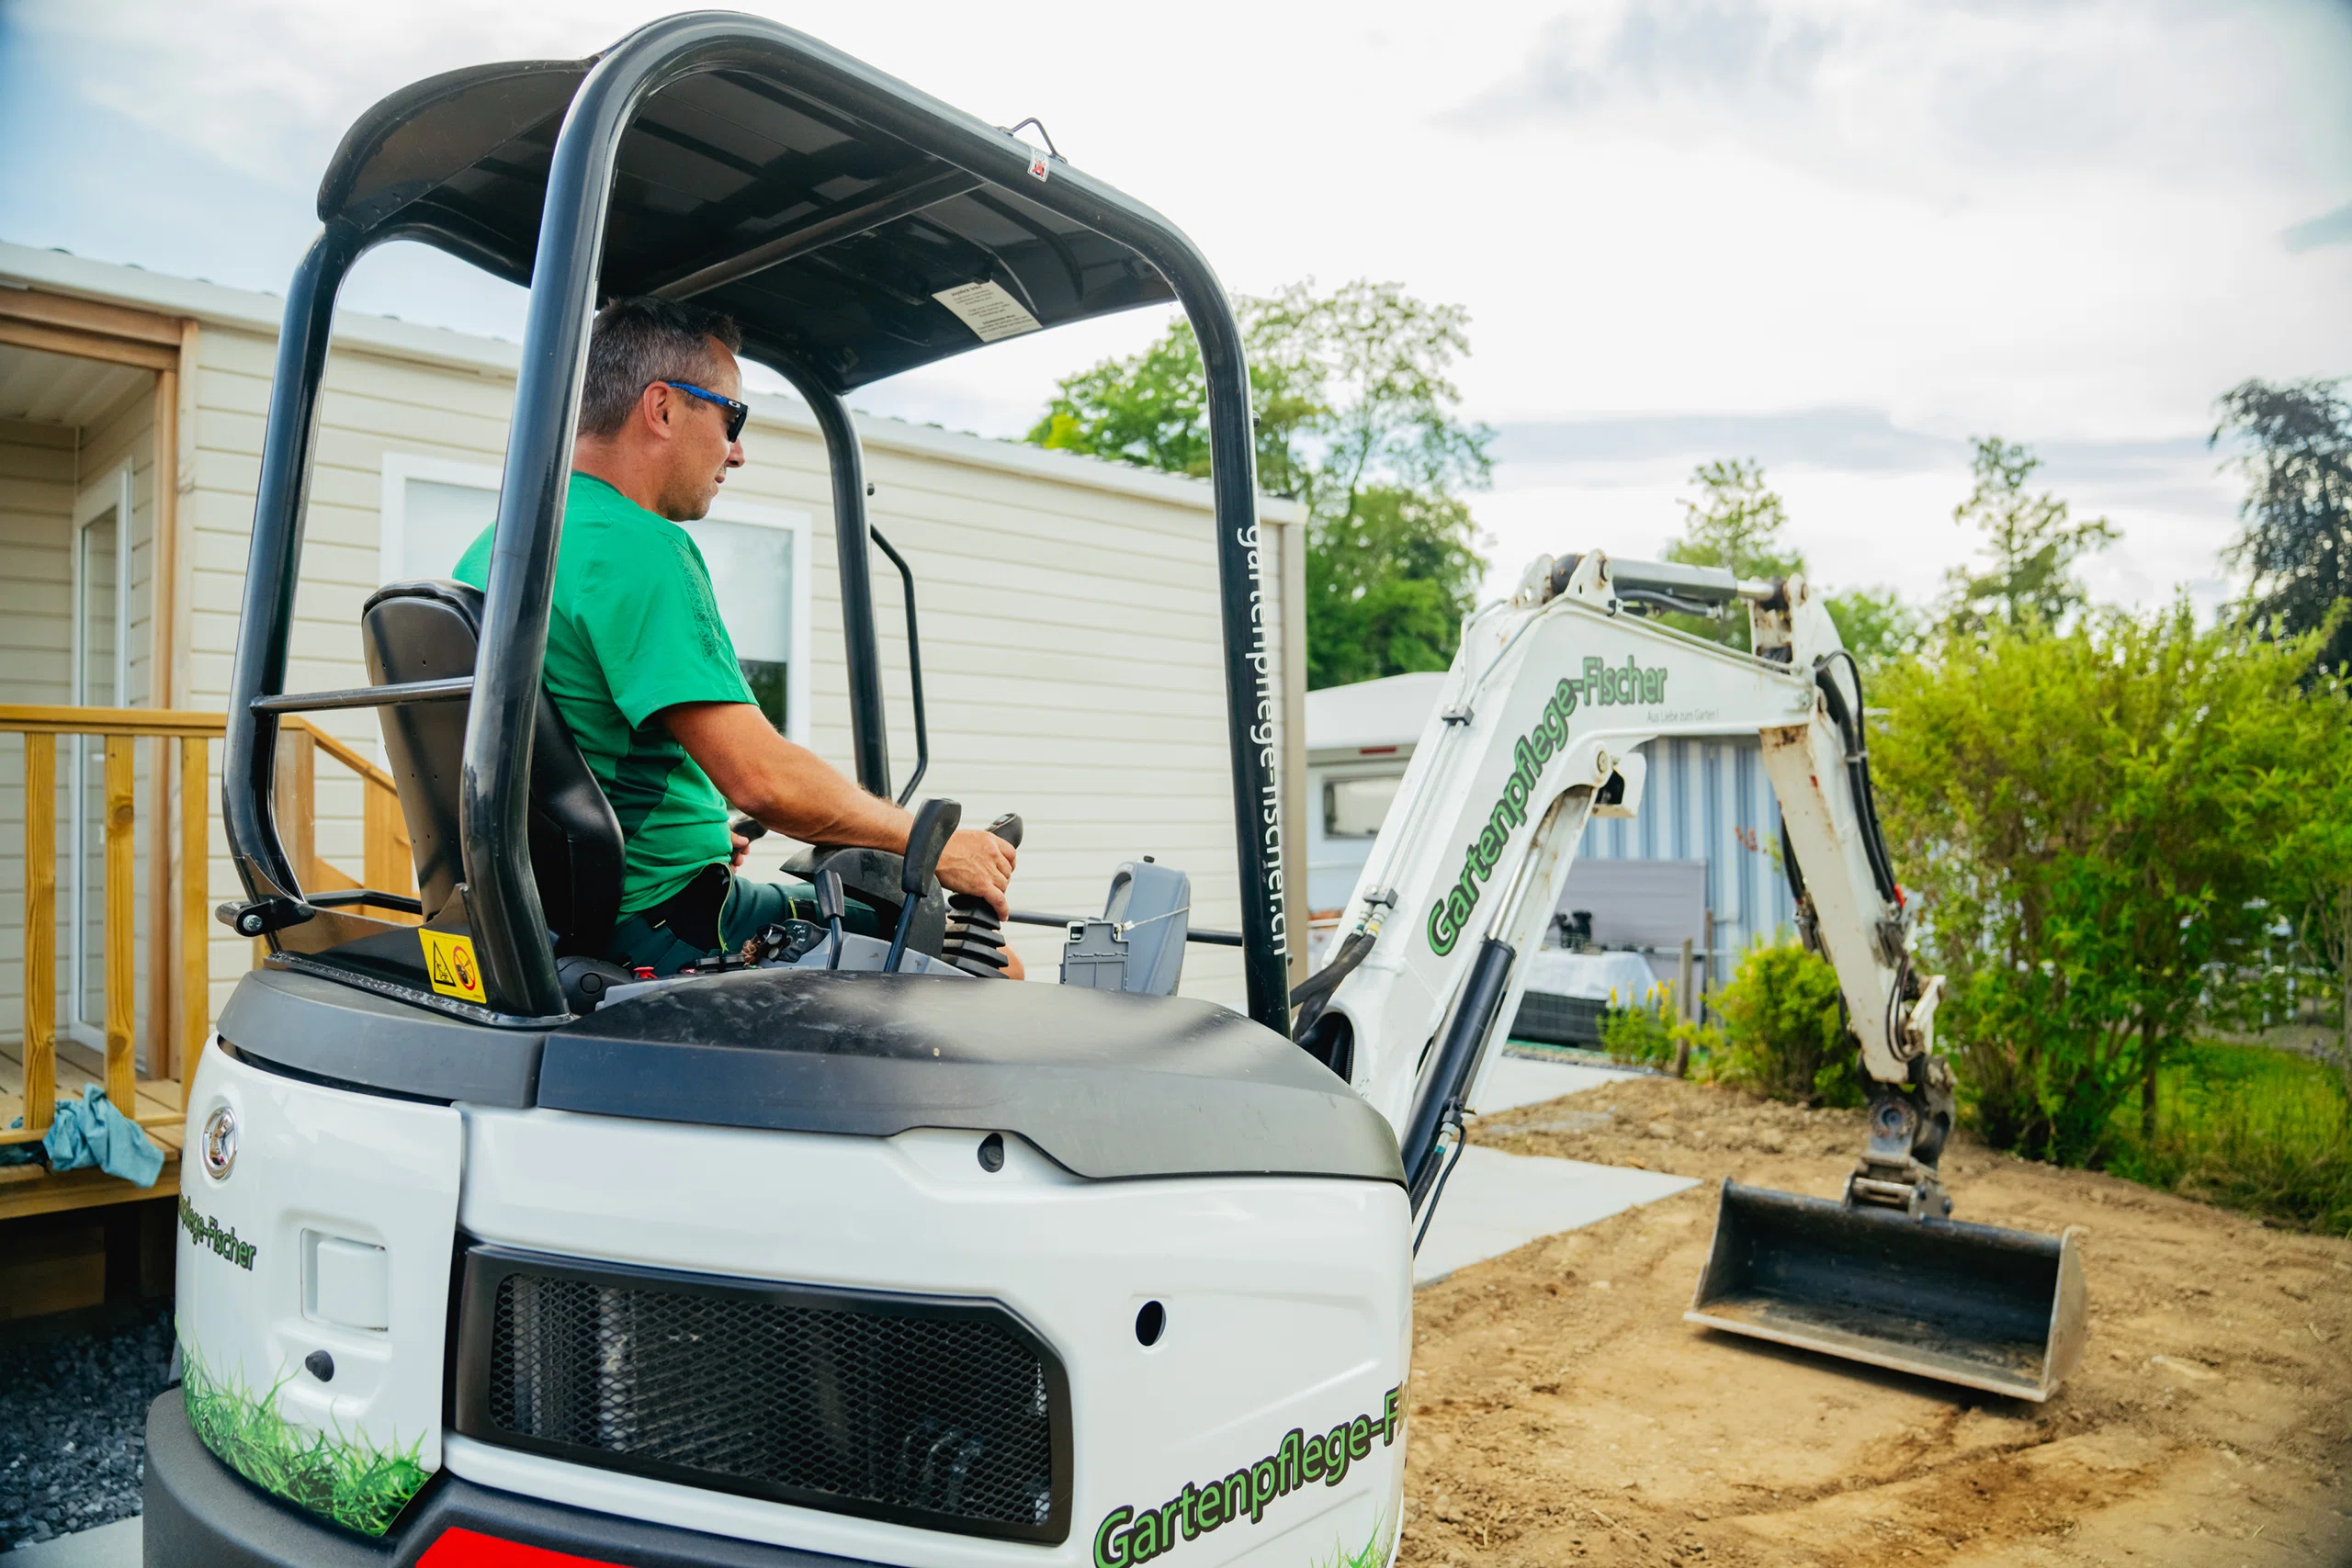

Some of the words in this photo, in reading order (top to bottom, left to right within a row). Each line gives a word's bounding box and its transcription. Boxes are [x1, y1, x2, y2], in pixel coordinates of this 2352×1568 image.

[1646, 709, 1659, 724] Aus
[1660, 708, 1679, 723] Liebe
[1679, 711, 1693, 722] zum
[1427, 655, 1668, 956] Gartenpflege-Fischer
